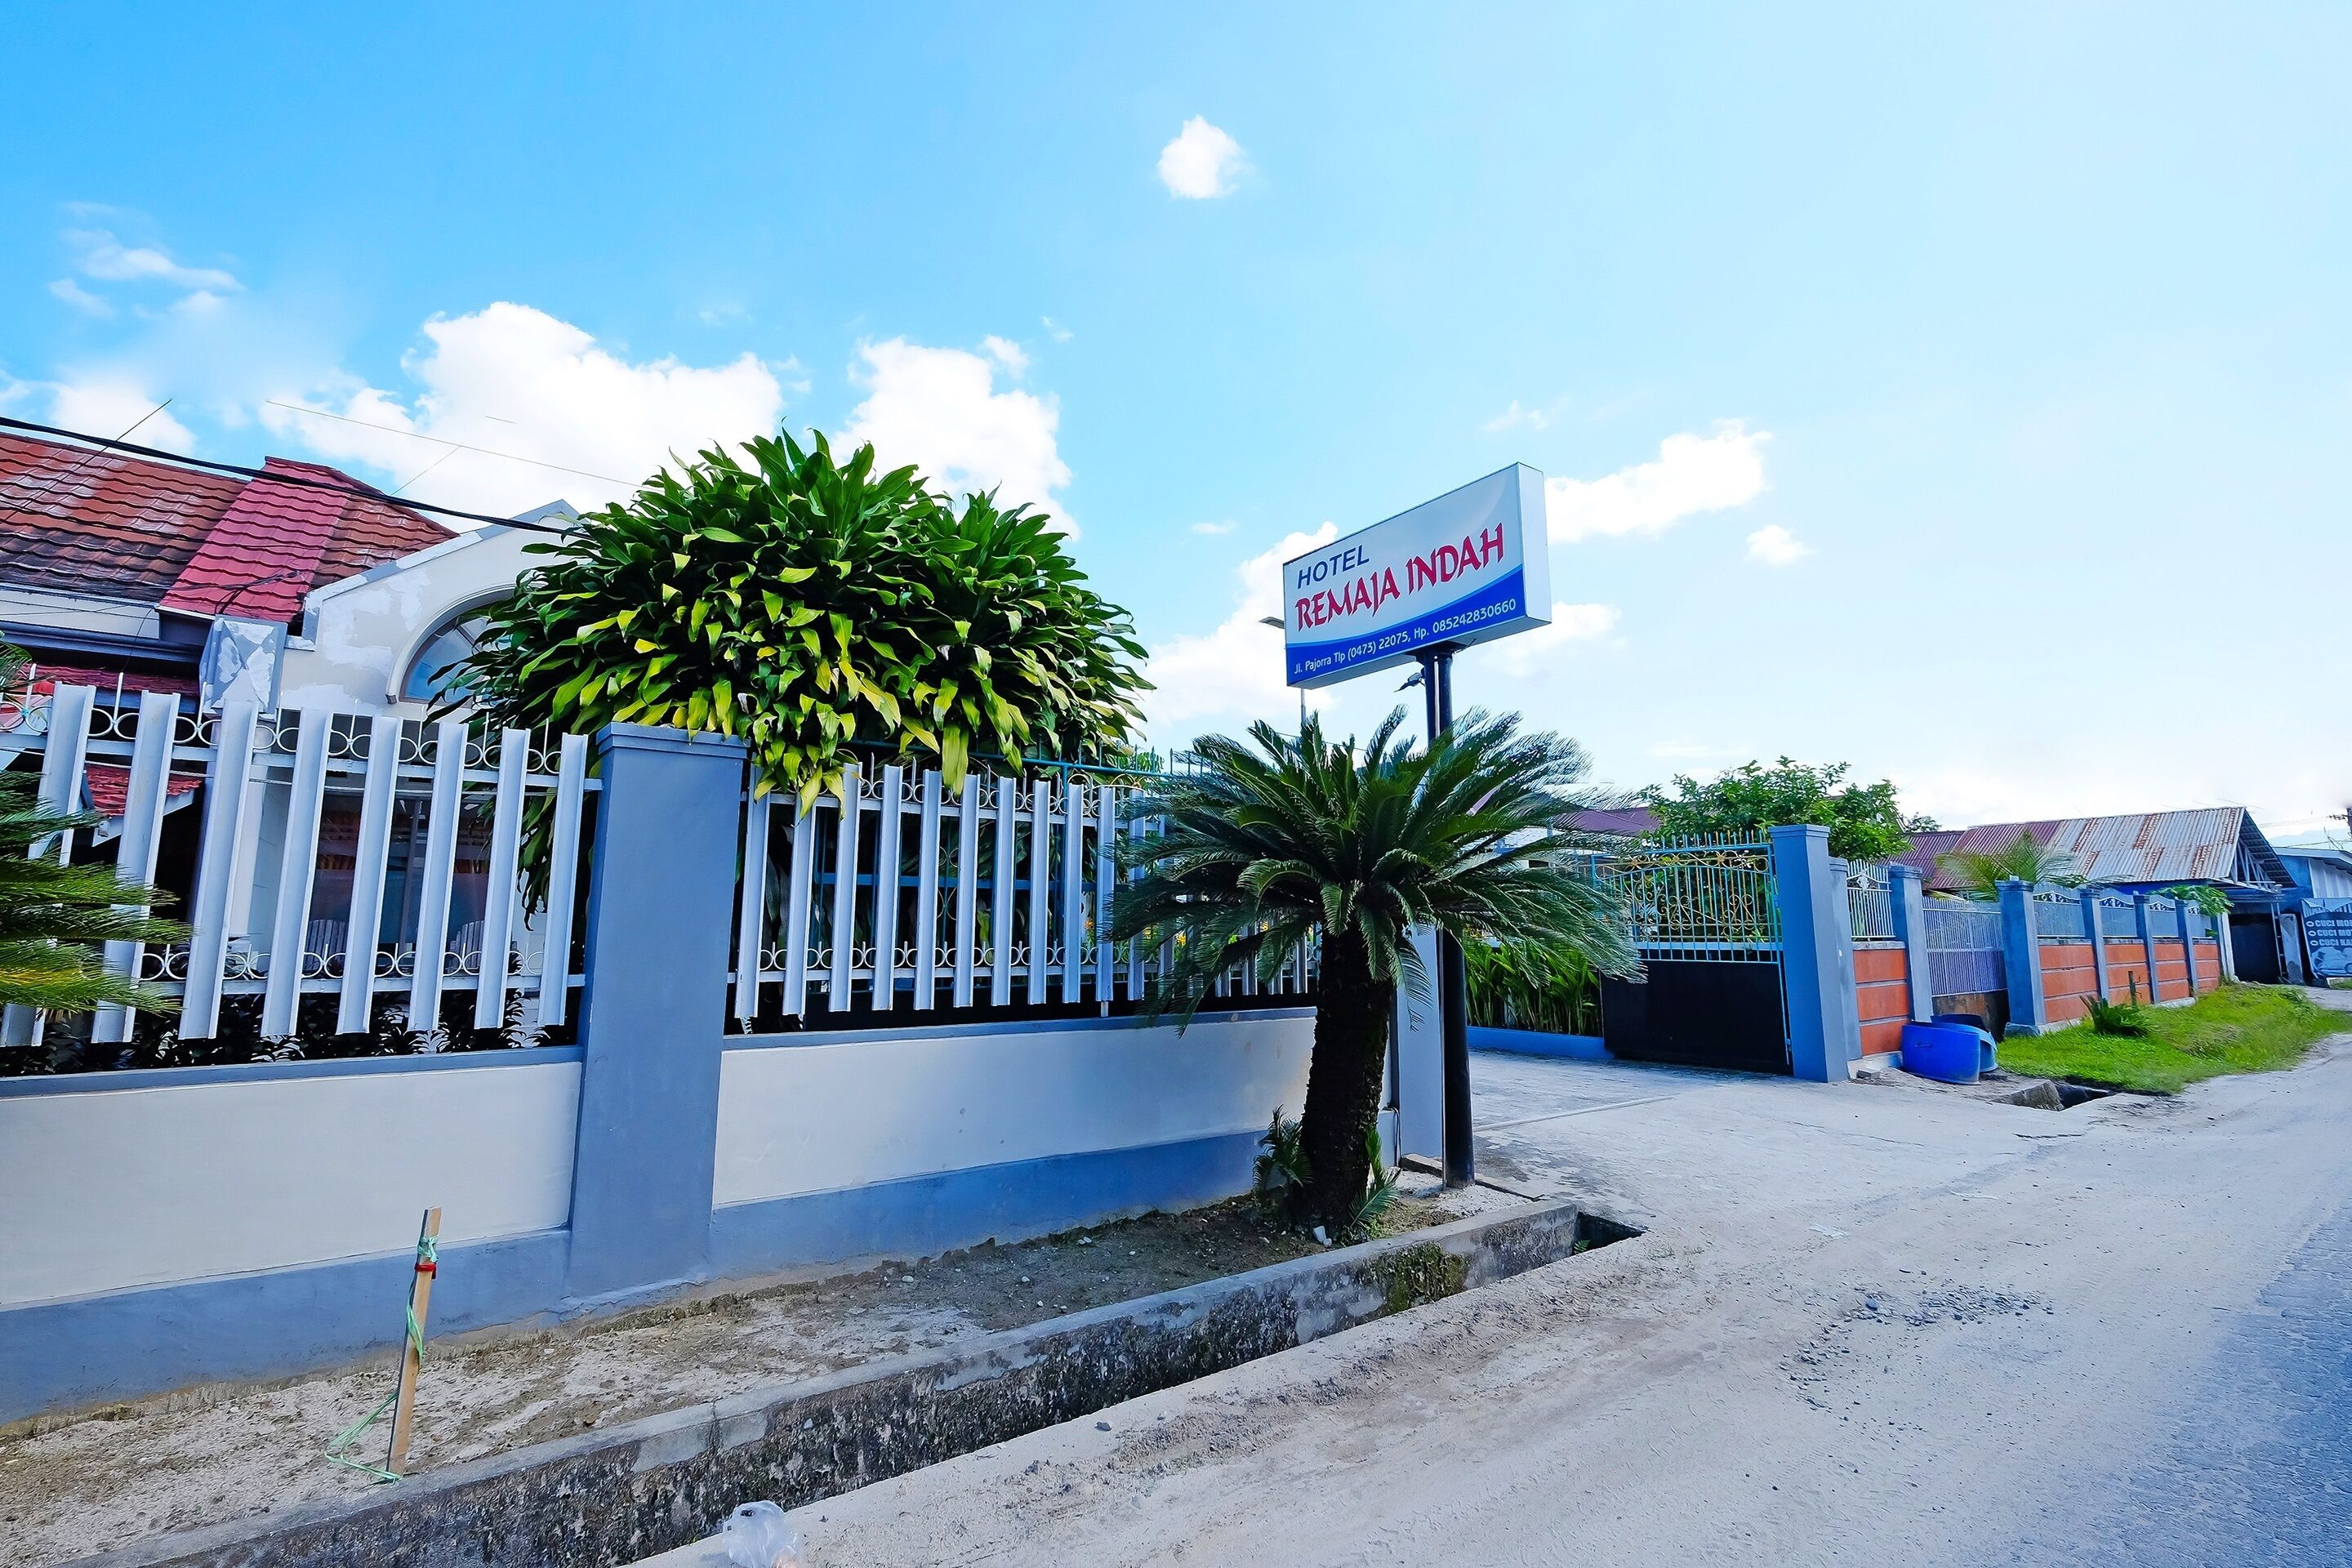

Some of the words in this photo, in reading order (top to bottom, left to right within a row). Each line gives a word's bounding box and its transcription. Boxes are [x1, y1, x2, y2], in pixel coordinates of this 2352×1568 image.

[1294, 566, 1401, 632] REMAJA
[1405, 523, 1503, 595] INDAH
[1298, 545, 1370, 589] HOTEL
[1294, 663, 1303, 675] Jl.
[1305, 657, 1332, 672] Pajorra
[1334, 652, 1346, 664] Tlp
[1348, 640, 1376, 662] (0473)
[1379, 630, 1411, 650] 22075,
[1414, 627, 1429, 640] Hp.
[1432, 598, 1517, 634] 085242830660
